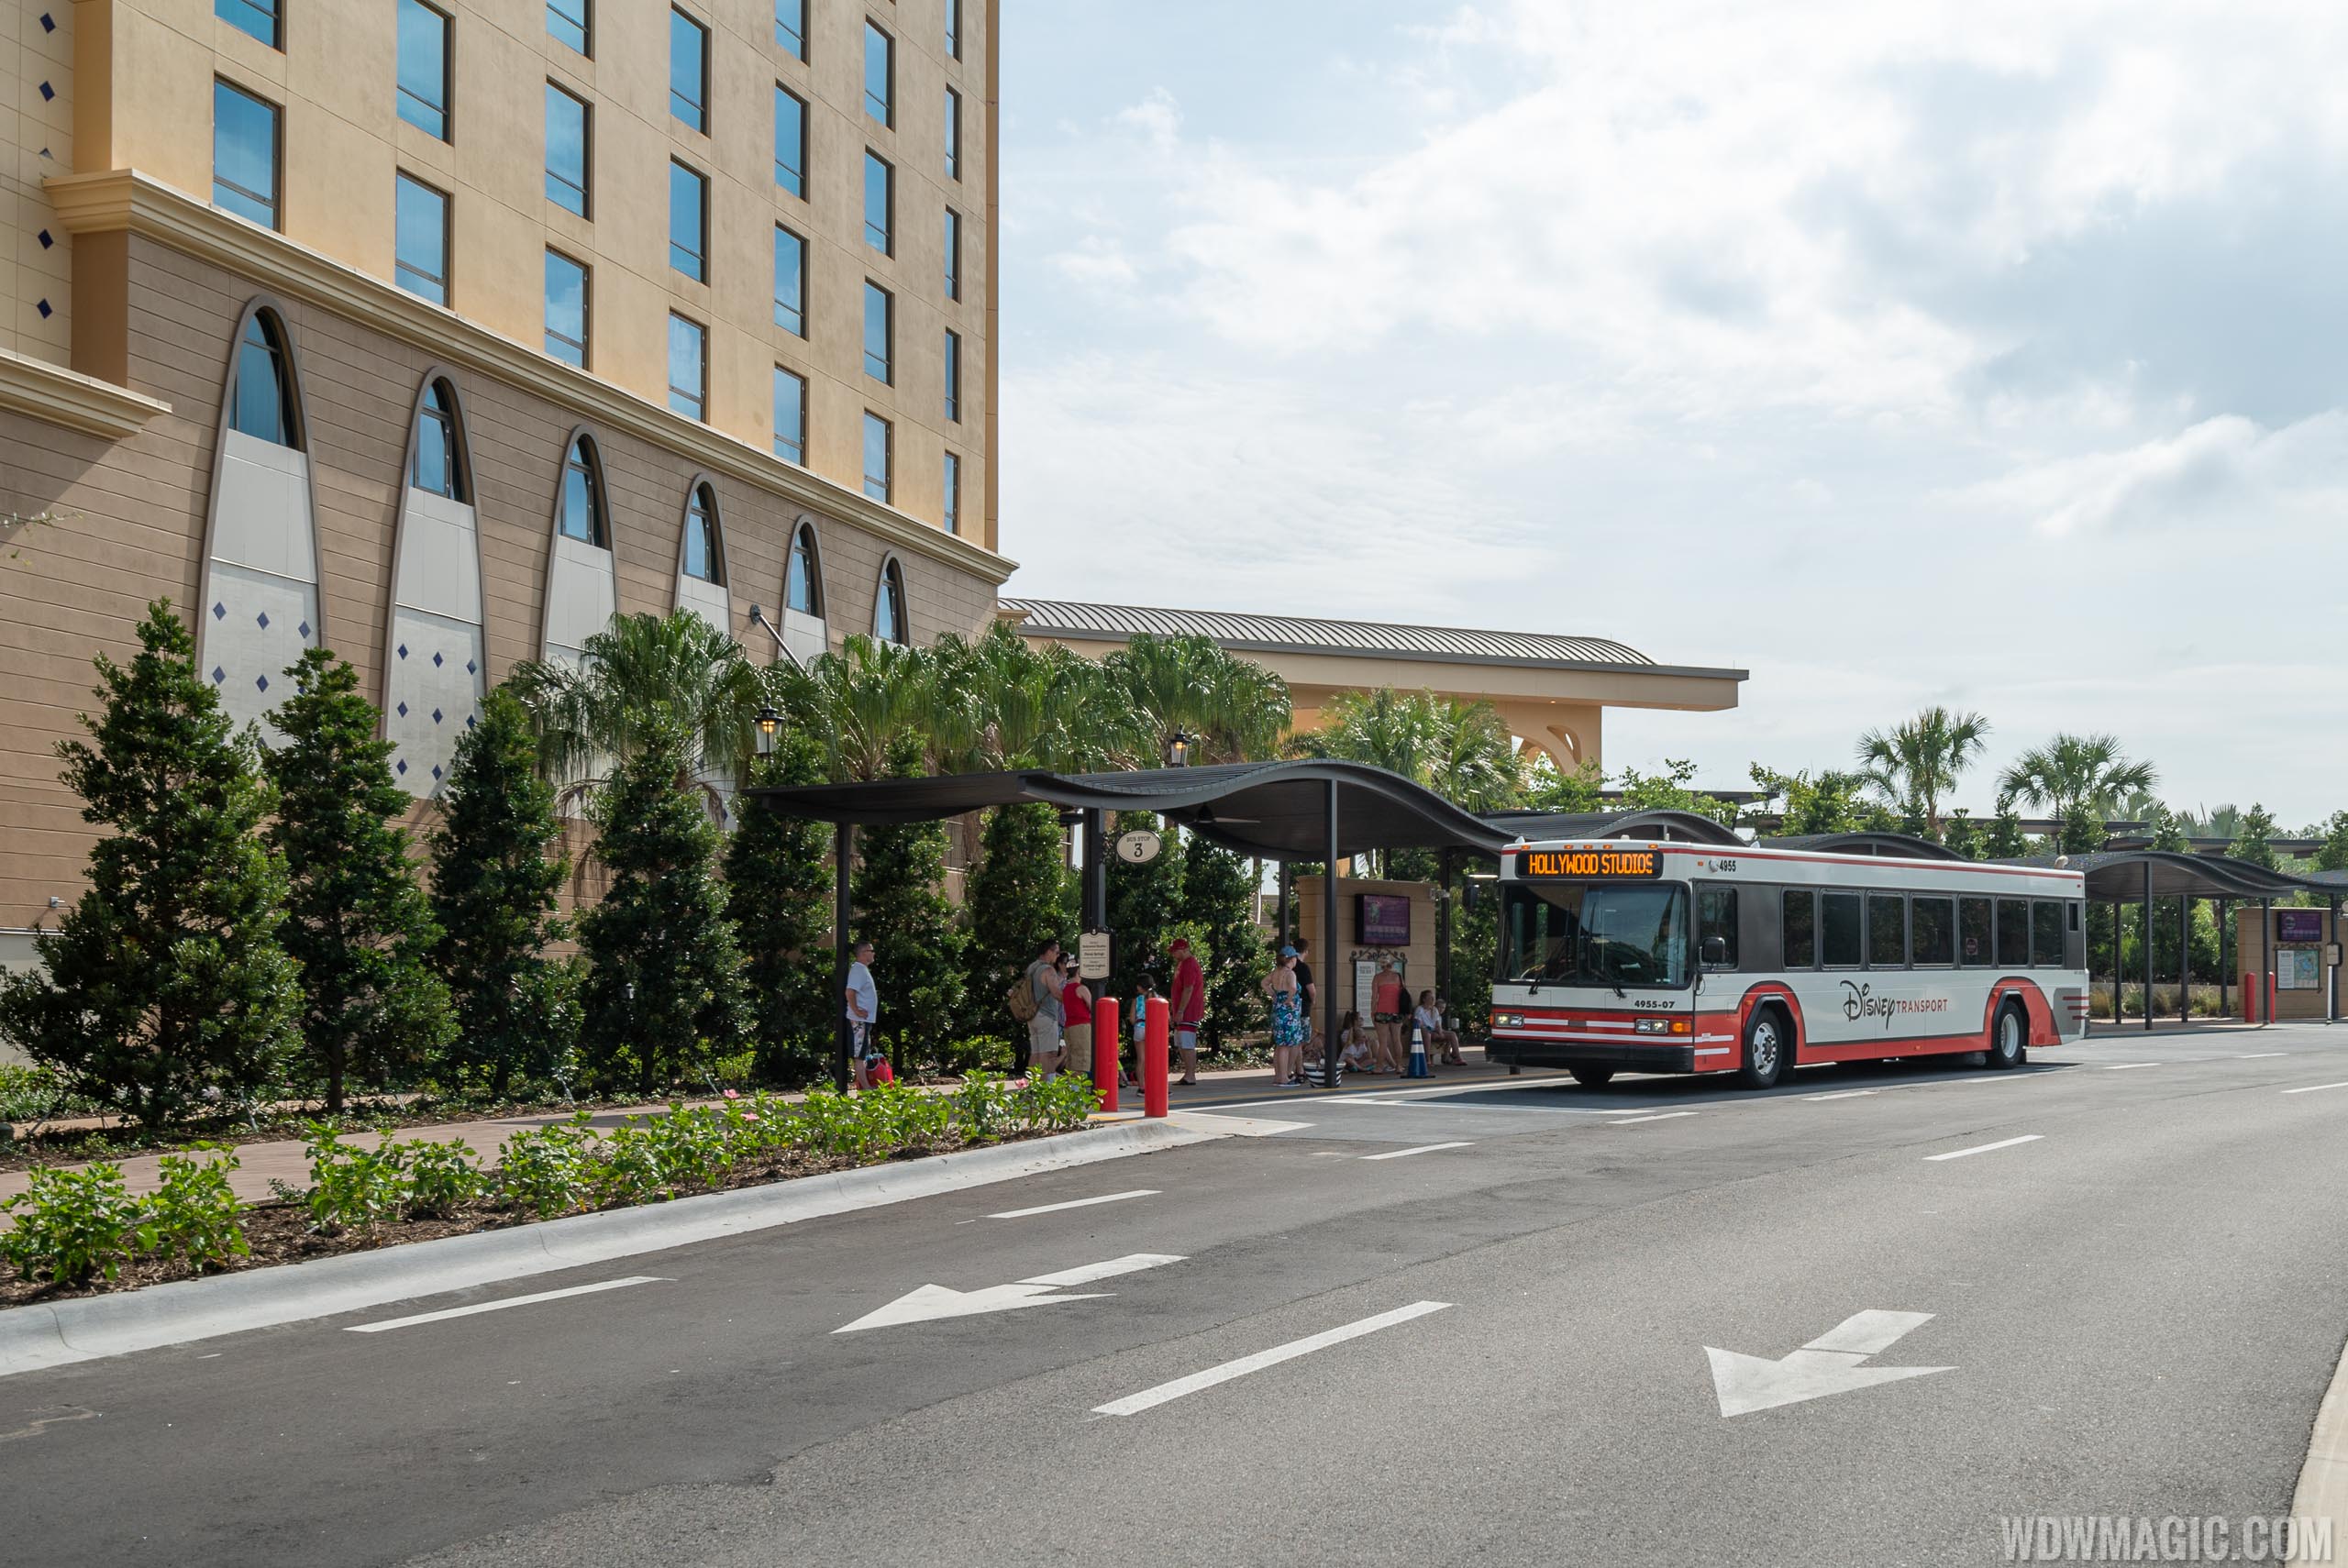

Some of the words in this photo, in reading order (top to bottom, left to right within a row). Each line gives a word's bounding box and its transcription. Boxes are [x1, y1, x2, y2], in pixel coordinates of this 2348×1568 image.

[1134, 843, 1143, 857] 3
[1529, 854, 1598, 875] HOLLYWOOD
[1601, 854, 1654, 875] STUDIOS
[1719, 859, 1737, 873] 4955
[1634, 999, 1676, 1009] 4955-07
[1896, 999, 1948, 1013] TRANSPORT
